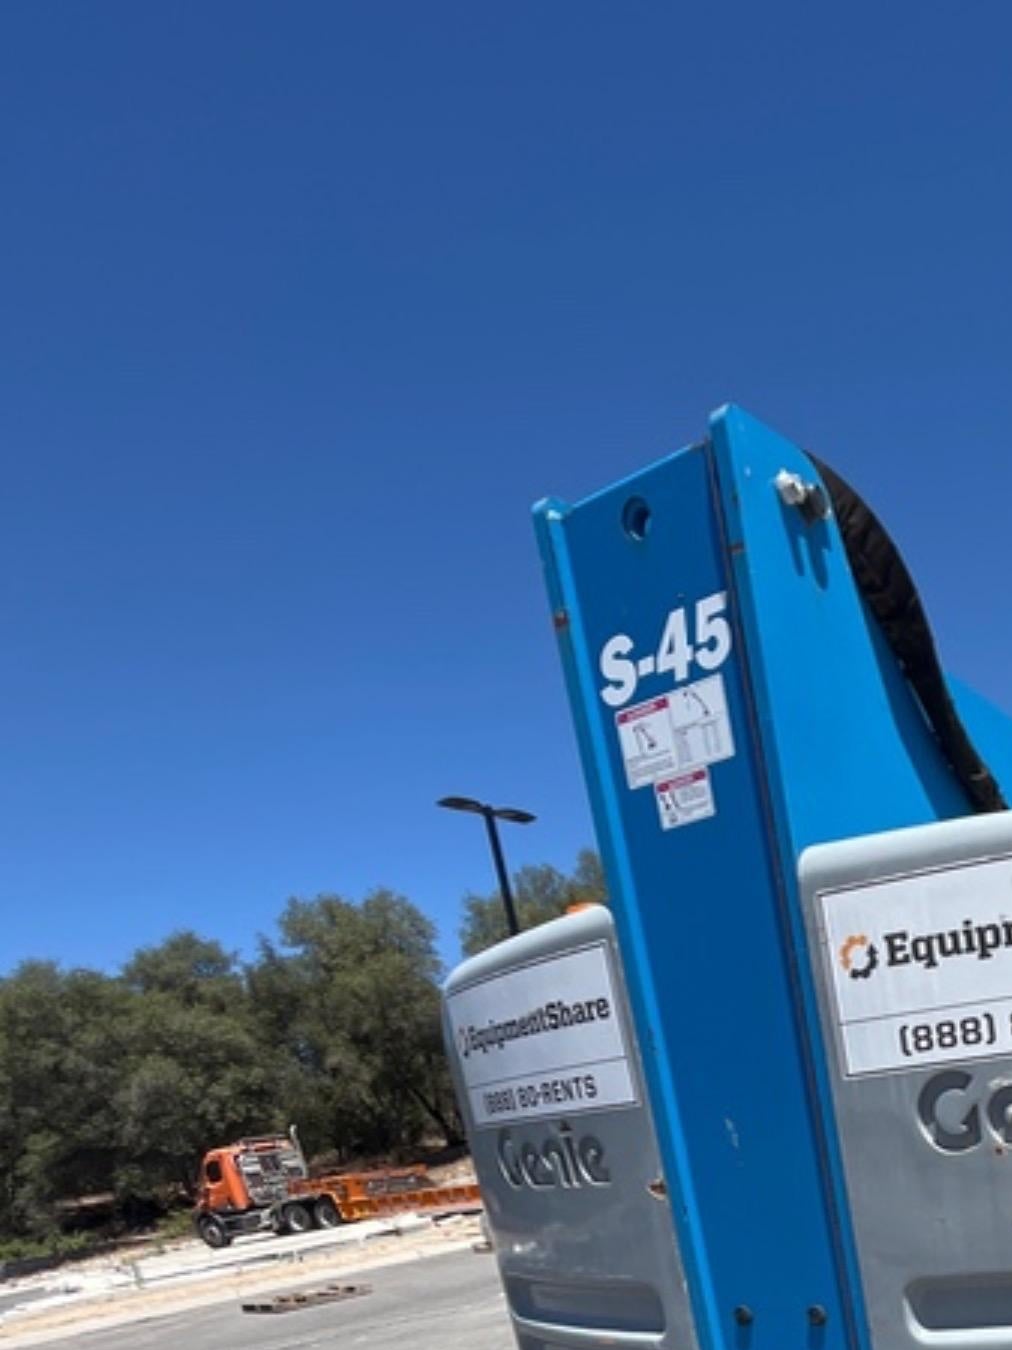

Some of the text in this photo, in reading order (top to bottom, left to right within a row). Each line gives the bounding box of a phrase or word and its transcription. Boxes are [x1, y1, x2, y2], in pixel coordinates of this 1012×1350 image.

[600, 591, 732, 707] S-45
[468, 997, 610, 1054] EquipmentShare
[899, 1012, 996, 1058] (888)
[517, 1074, 598, 1109] 80-RENTS
[498, 1120, 612, 1190] Genie
